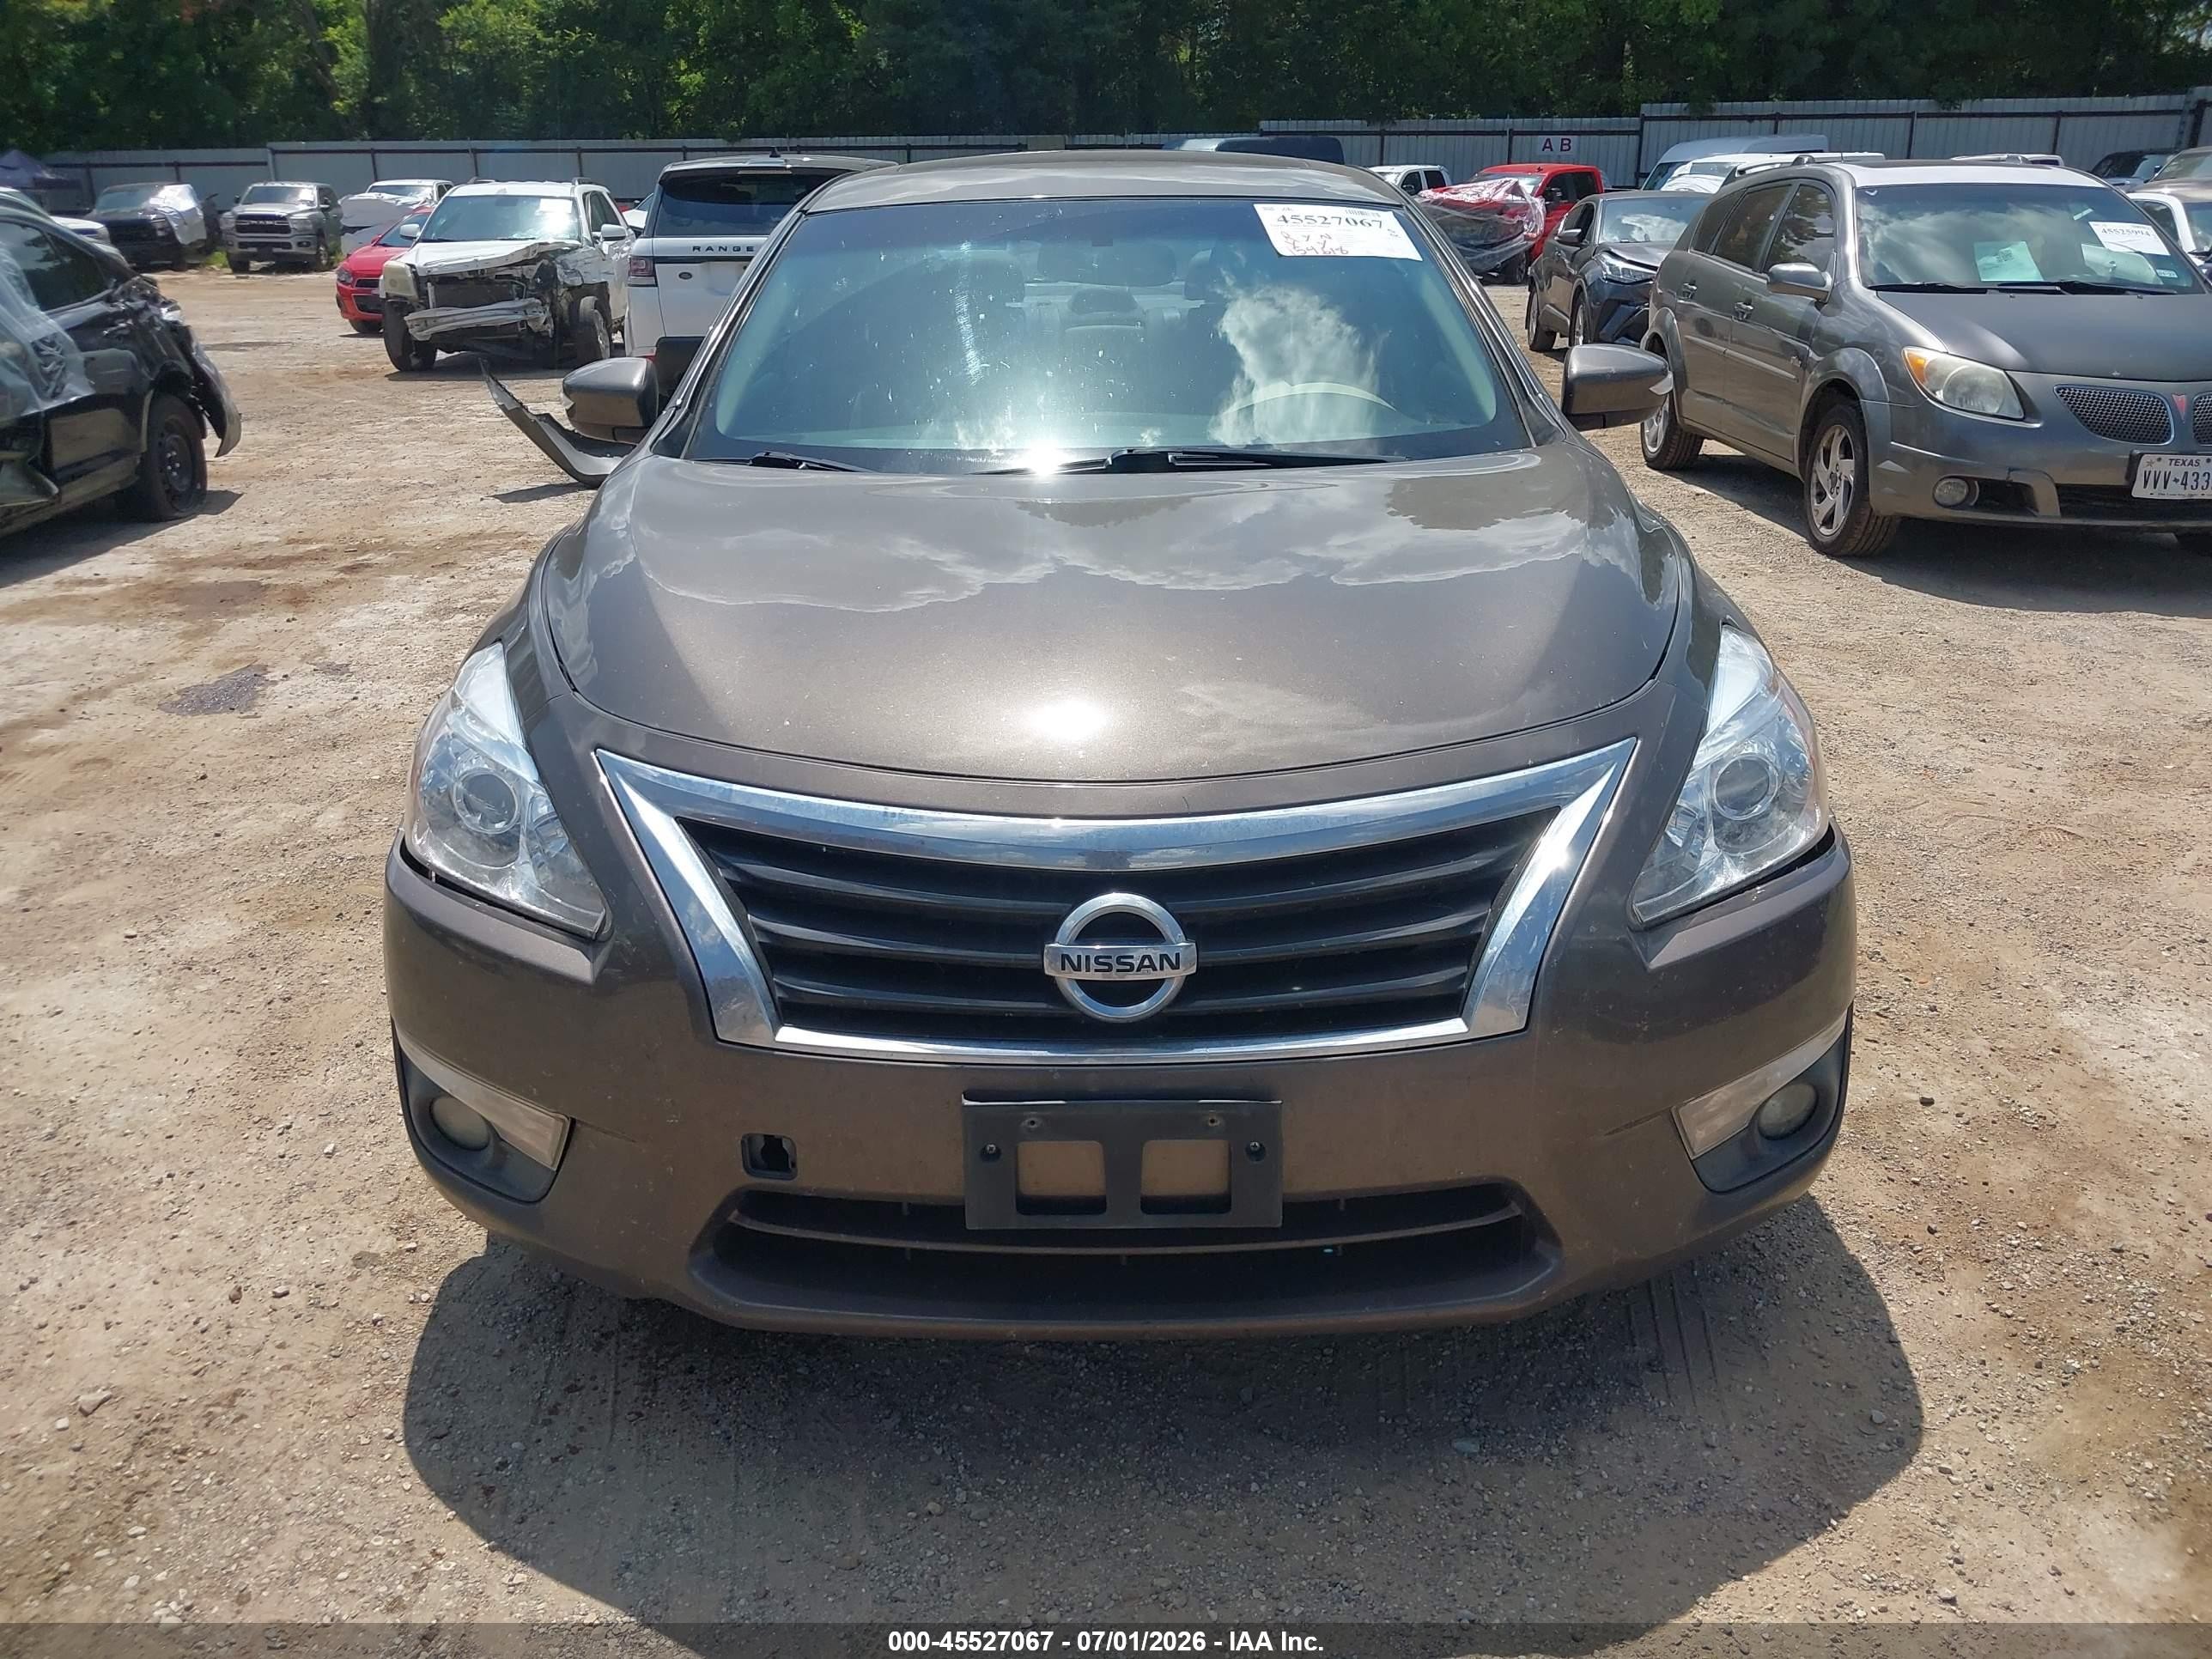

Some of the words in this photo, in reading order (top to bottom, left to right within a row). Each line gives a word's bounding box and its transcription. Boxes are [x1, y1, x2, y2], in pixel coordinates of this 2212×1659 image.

[1541, 137, 1553, 152] A
[1559, 137, 1571, 152] B
[1277, 214, 1382, 228] 45527067
[2168, 458, 2201, 467] TEXAS
[1060, 952, 1181, 973] NISSAN
